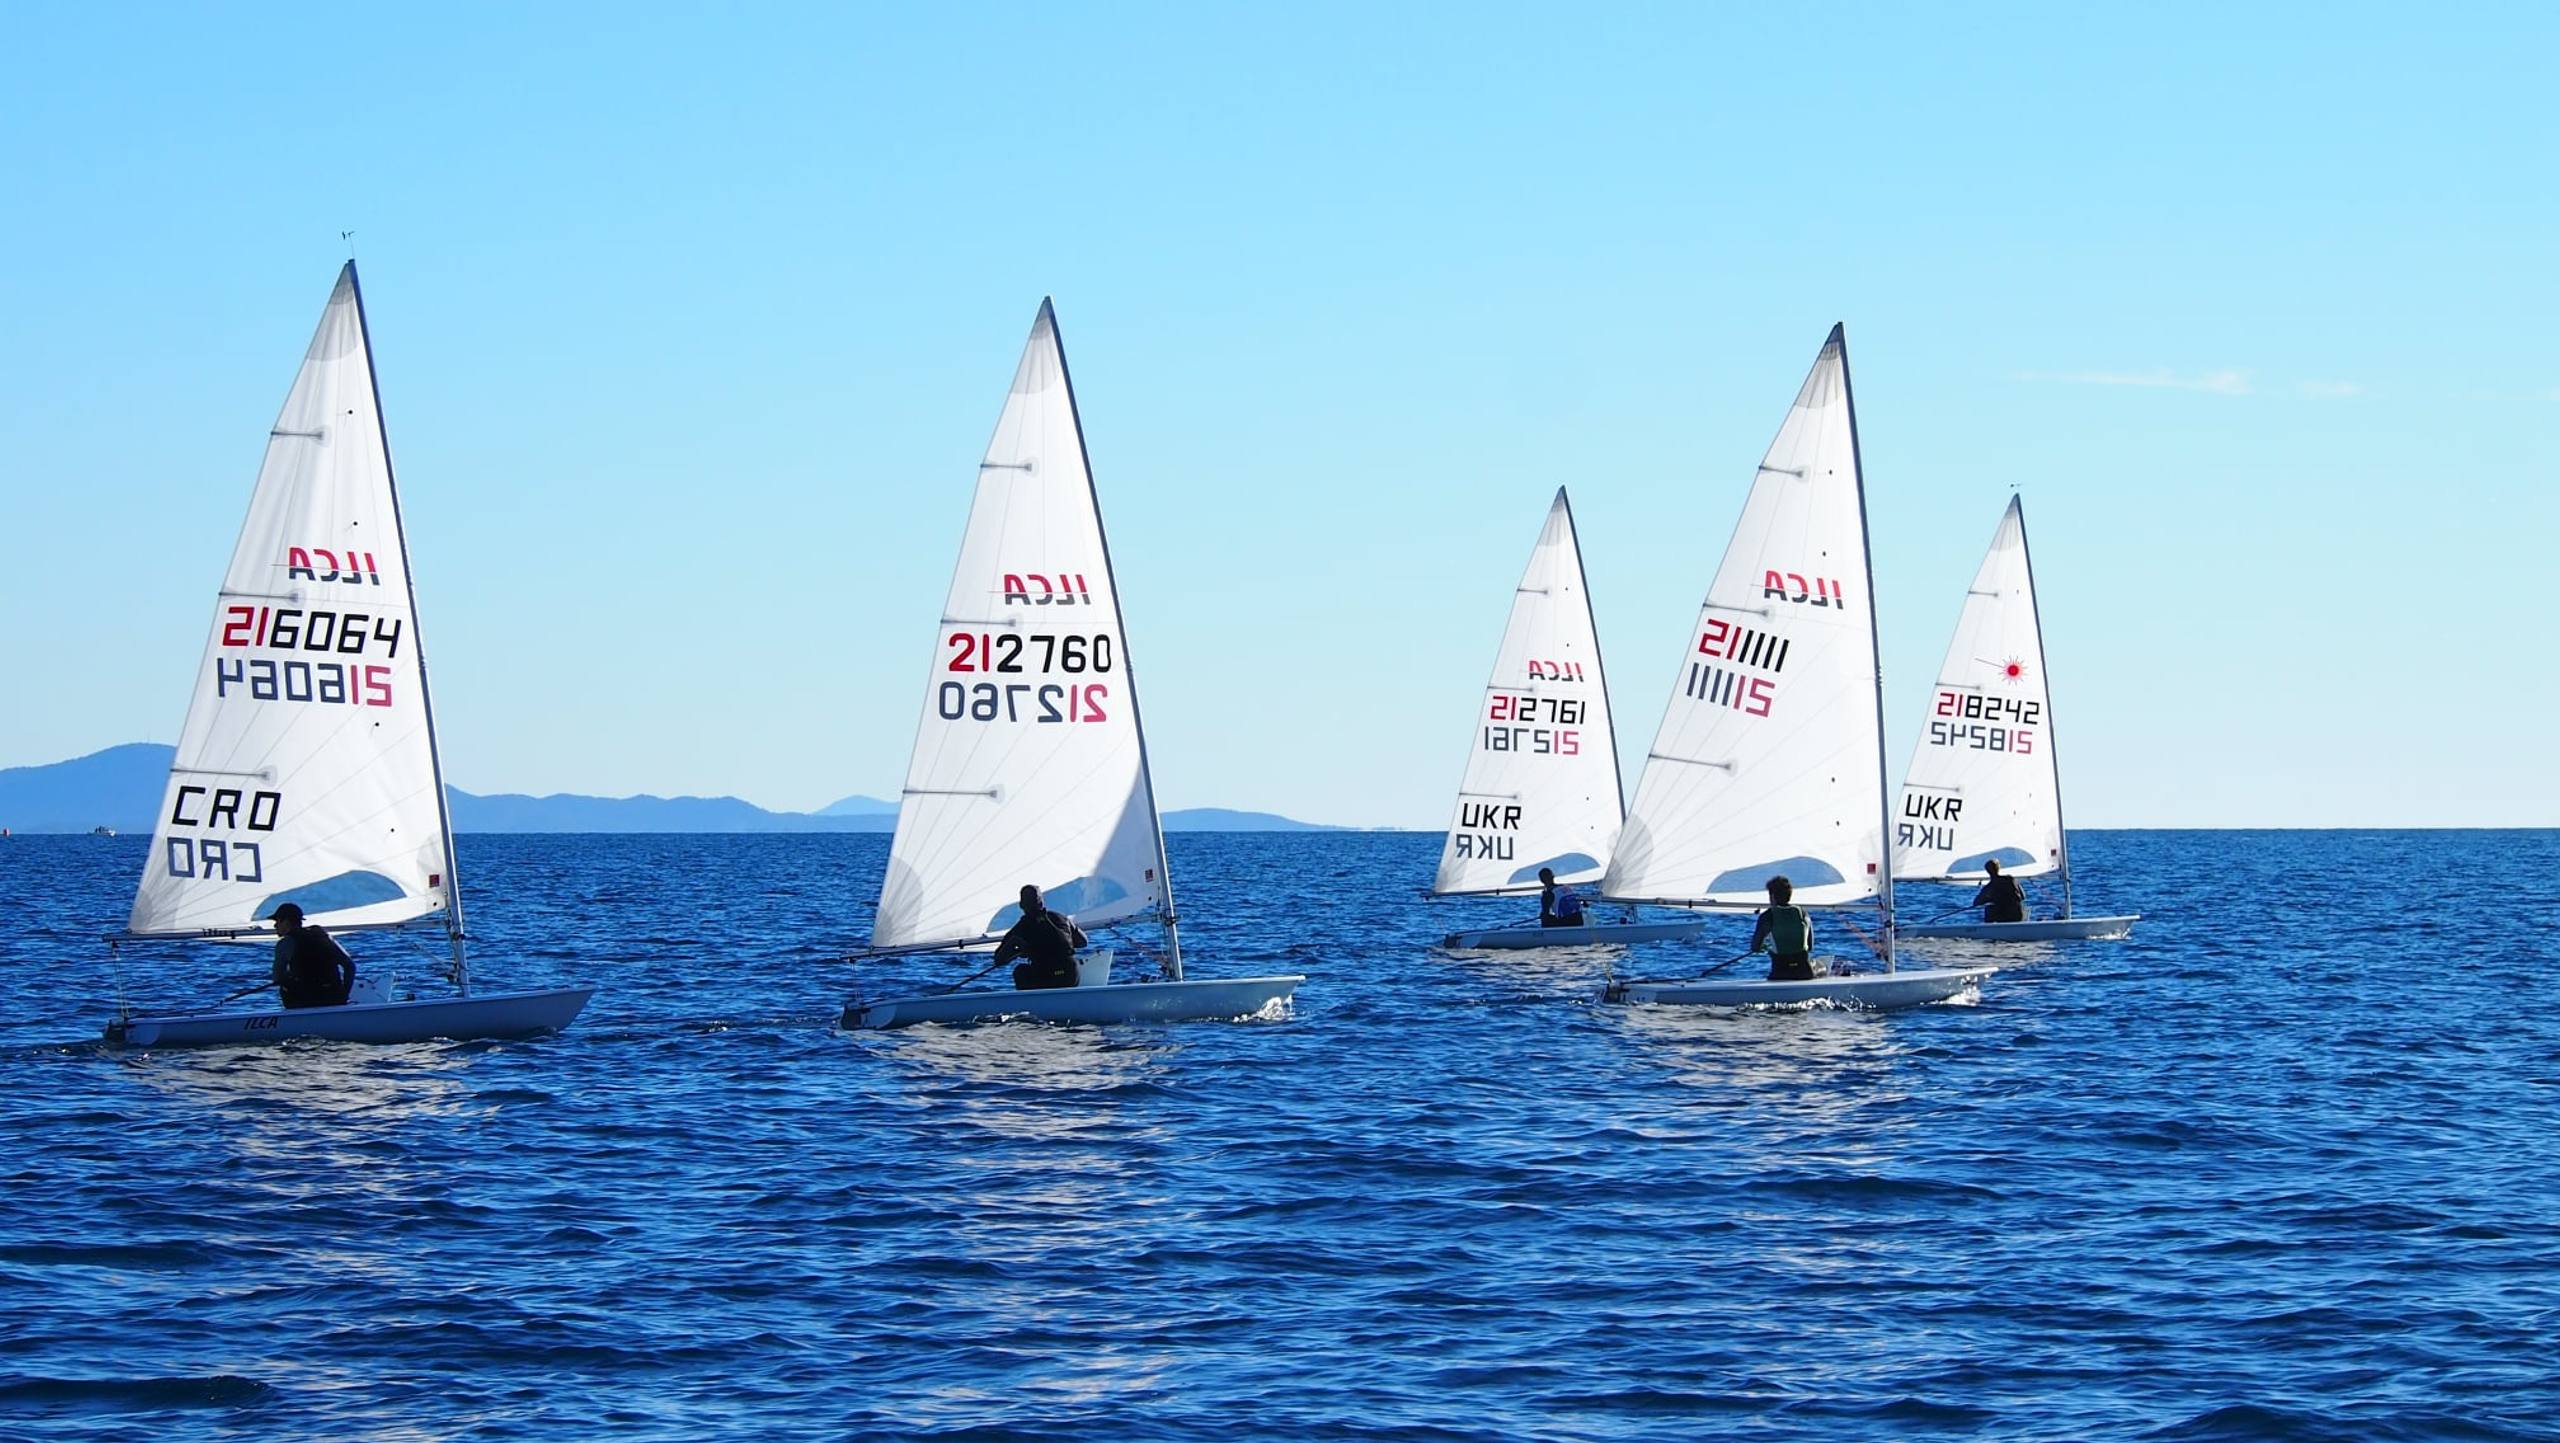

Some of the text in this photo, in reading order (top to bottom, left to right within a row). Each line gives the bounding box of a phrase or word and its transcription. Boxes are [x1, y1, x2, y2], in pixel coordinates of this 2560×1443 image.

[222, 606, 402, 659] 216064
[1698, 618, 1790, 673] 211111
[948, 632, 1112, 674] 212760
[1490, 695, 1586, 725] 212761
[1936, 692, 2040, 725] 218242
[171, 785, 282, 832] CRO
[1461, 802, 1522, 831] UKR
[1905, 793, 1963, 822] UKR
